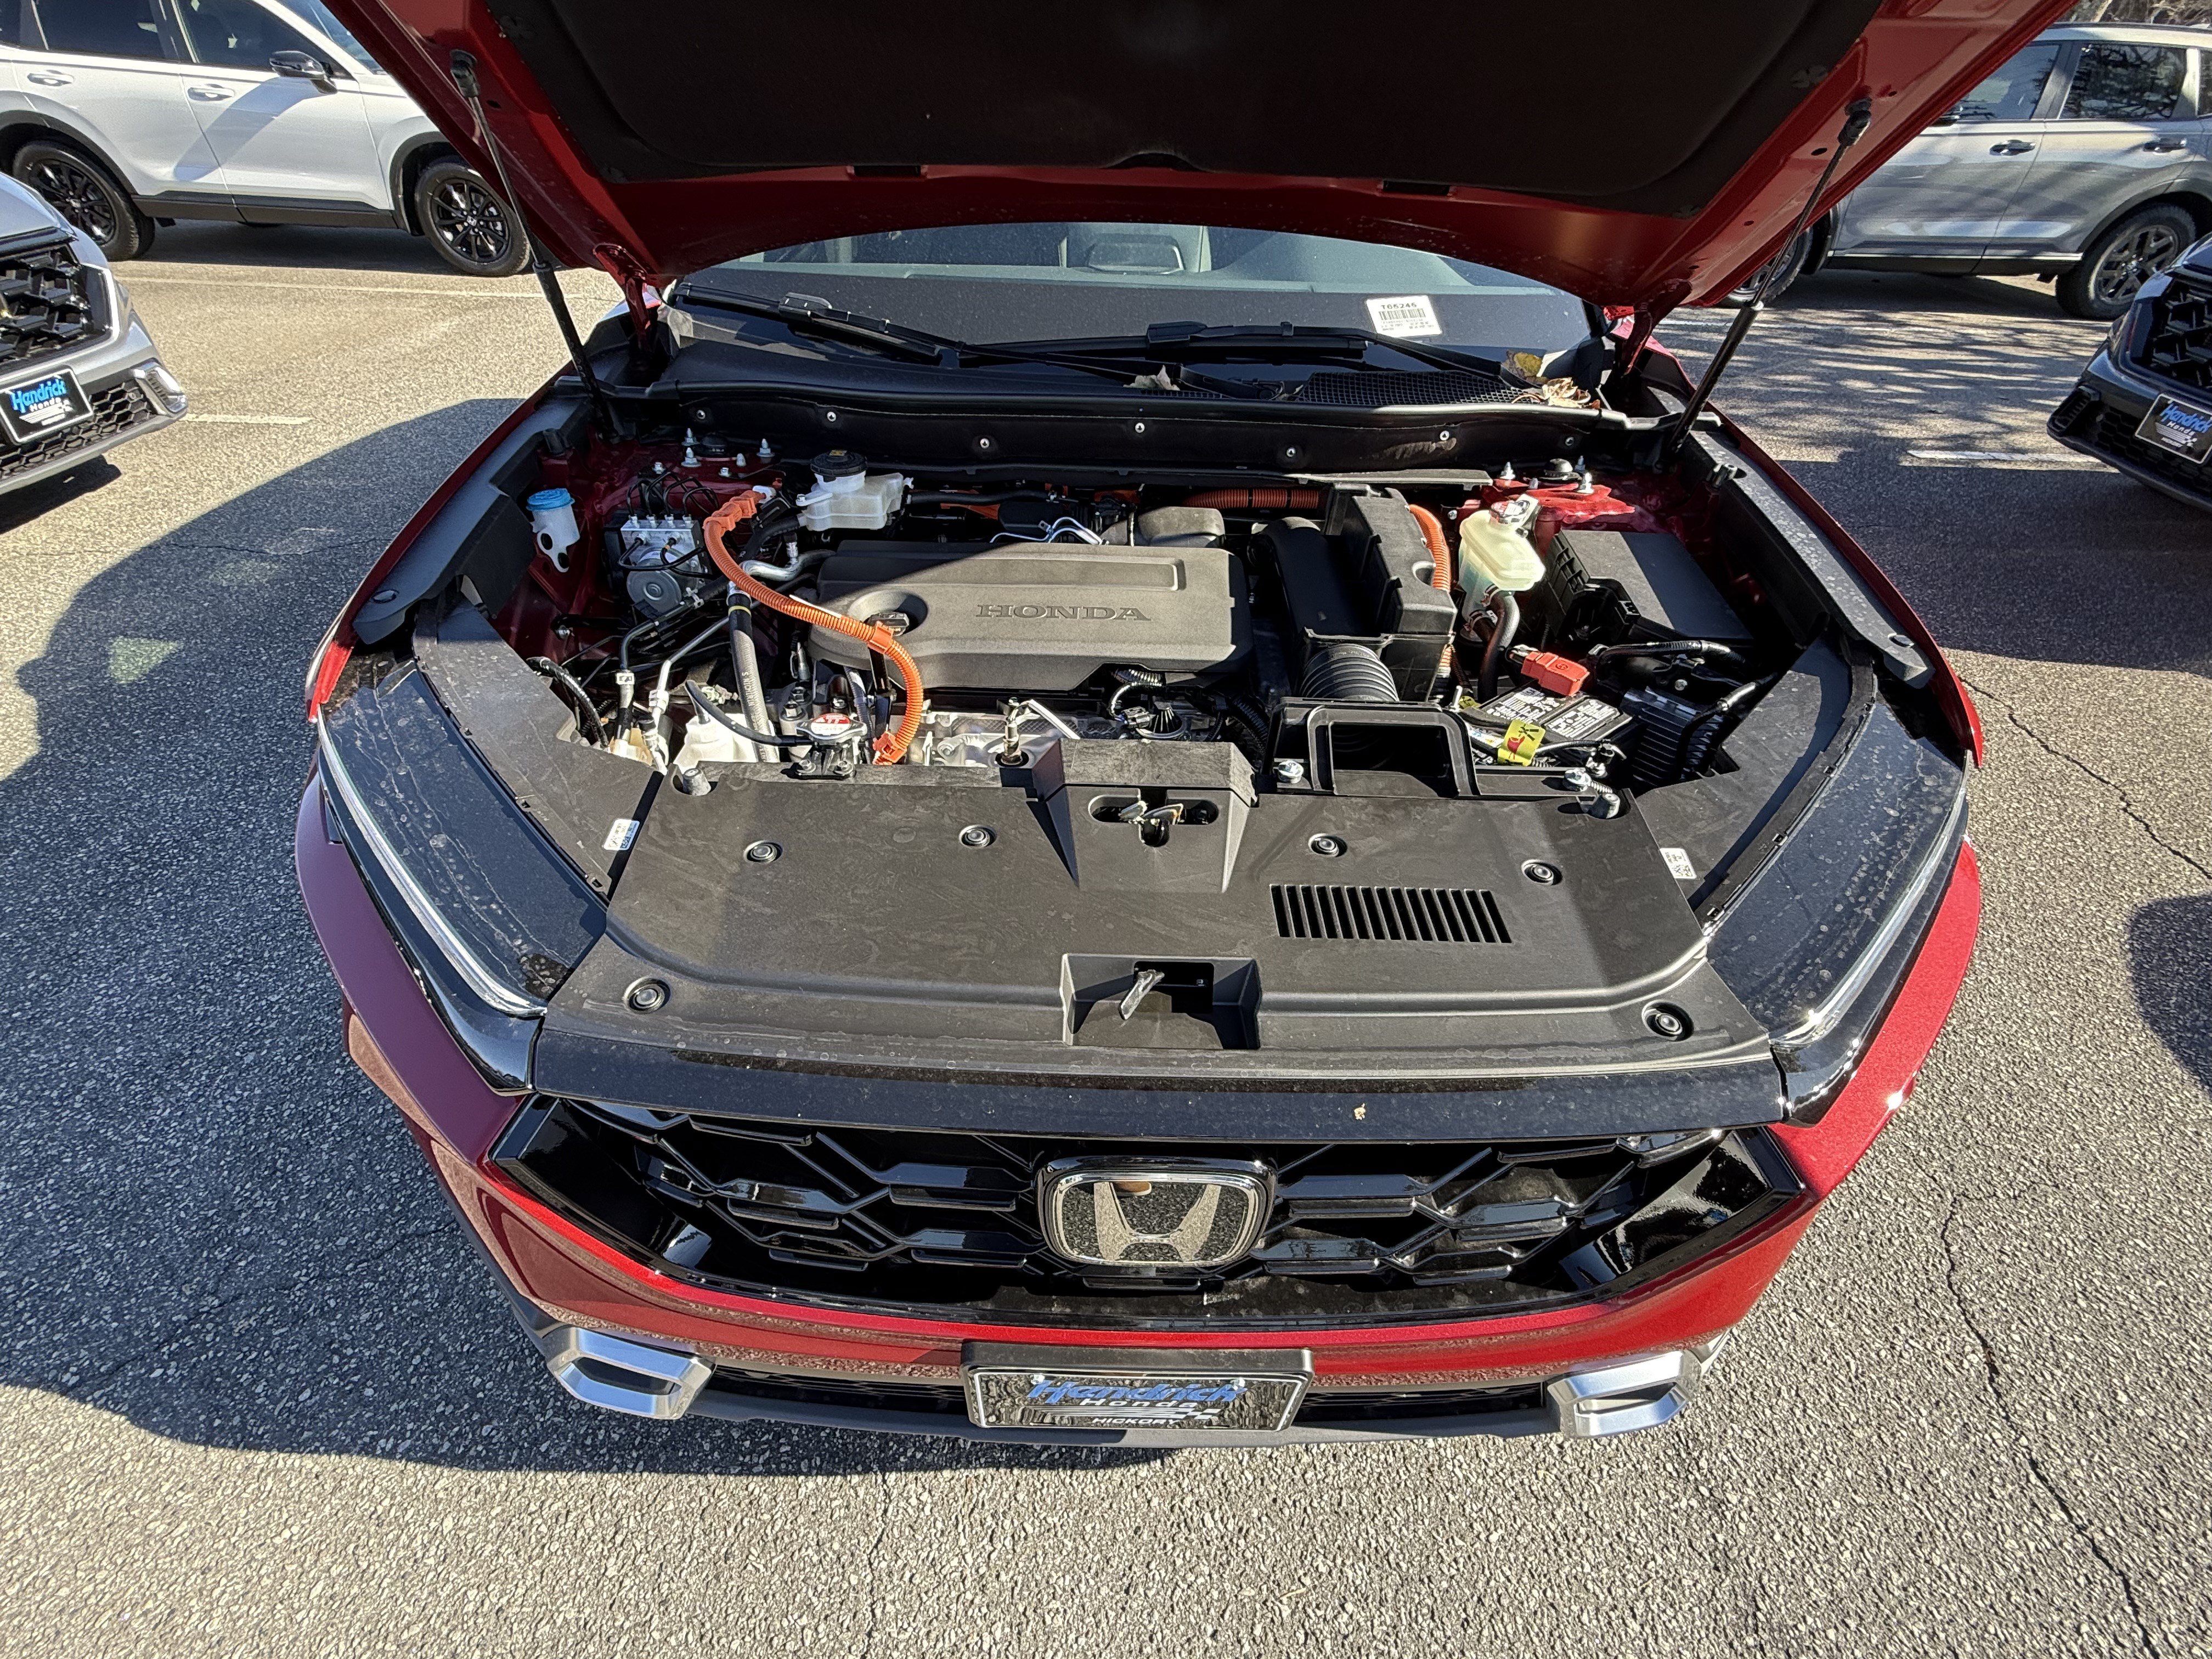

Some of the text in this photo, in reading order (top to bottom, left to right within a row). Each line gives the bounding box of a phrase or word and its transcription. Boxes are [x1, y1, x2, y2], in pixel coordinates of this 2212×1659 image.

[976, 604, 1152, 621] HONDA
[1027, 1380, 1248, 1404] Hendrick
[1079, 1398, 1198, 1408] Honda
